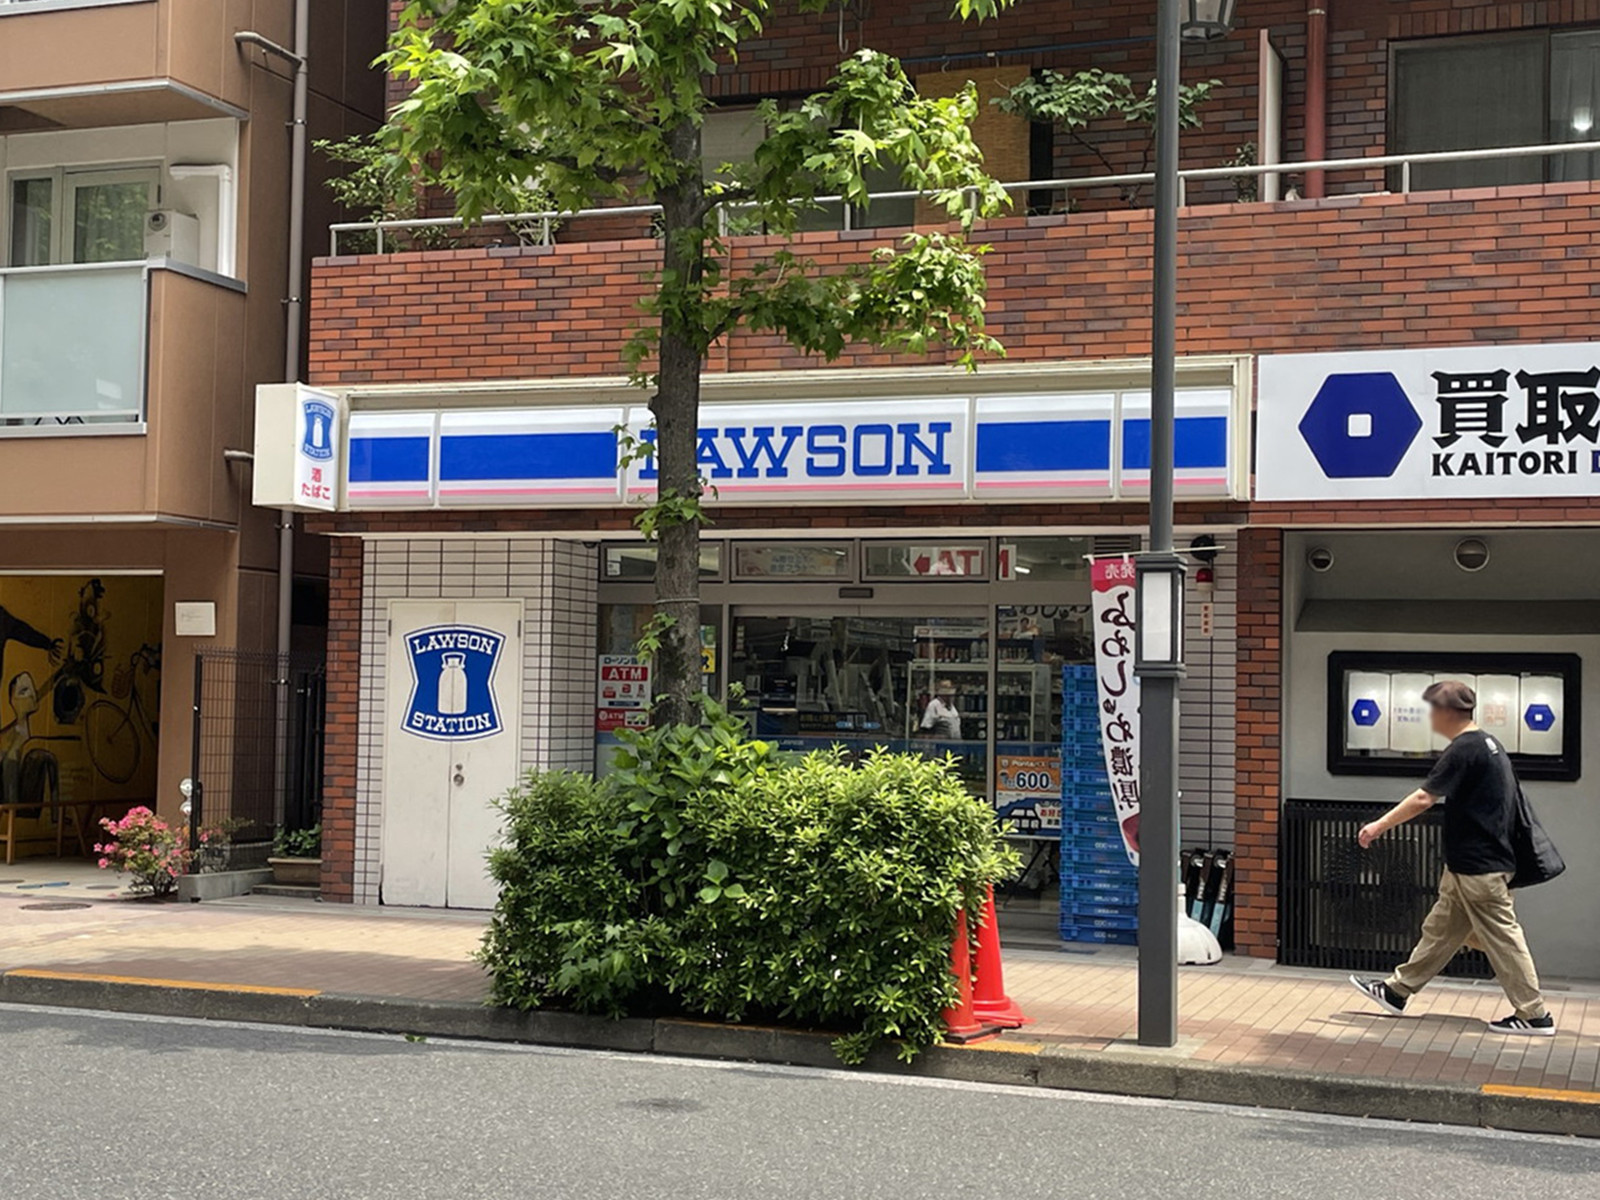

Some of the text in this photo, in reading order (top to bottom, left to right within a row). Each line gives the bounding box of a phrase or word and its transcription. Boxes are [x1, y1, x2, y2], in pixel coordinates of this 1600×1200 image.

[1430, 366, 1600, 449] 買取
[1431, 450, 1578, 477] KAITORI
[311, 467, 322, 483] 酒
[301, 482, 331, 501] たばこ
[413, 633, 495, 655] LAWSON
[603, 656, 646, 665] ローソン
[609, 668, 642, 680] ATM
[412, 711, 492, 732] STATION
[1016, 771, 1050, 789] 600
